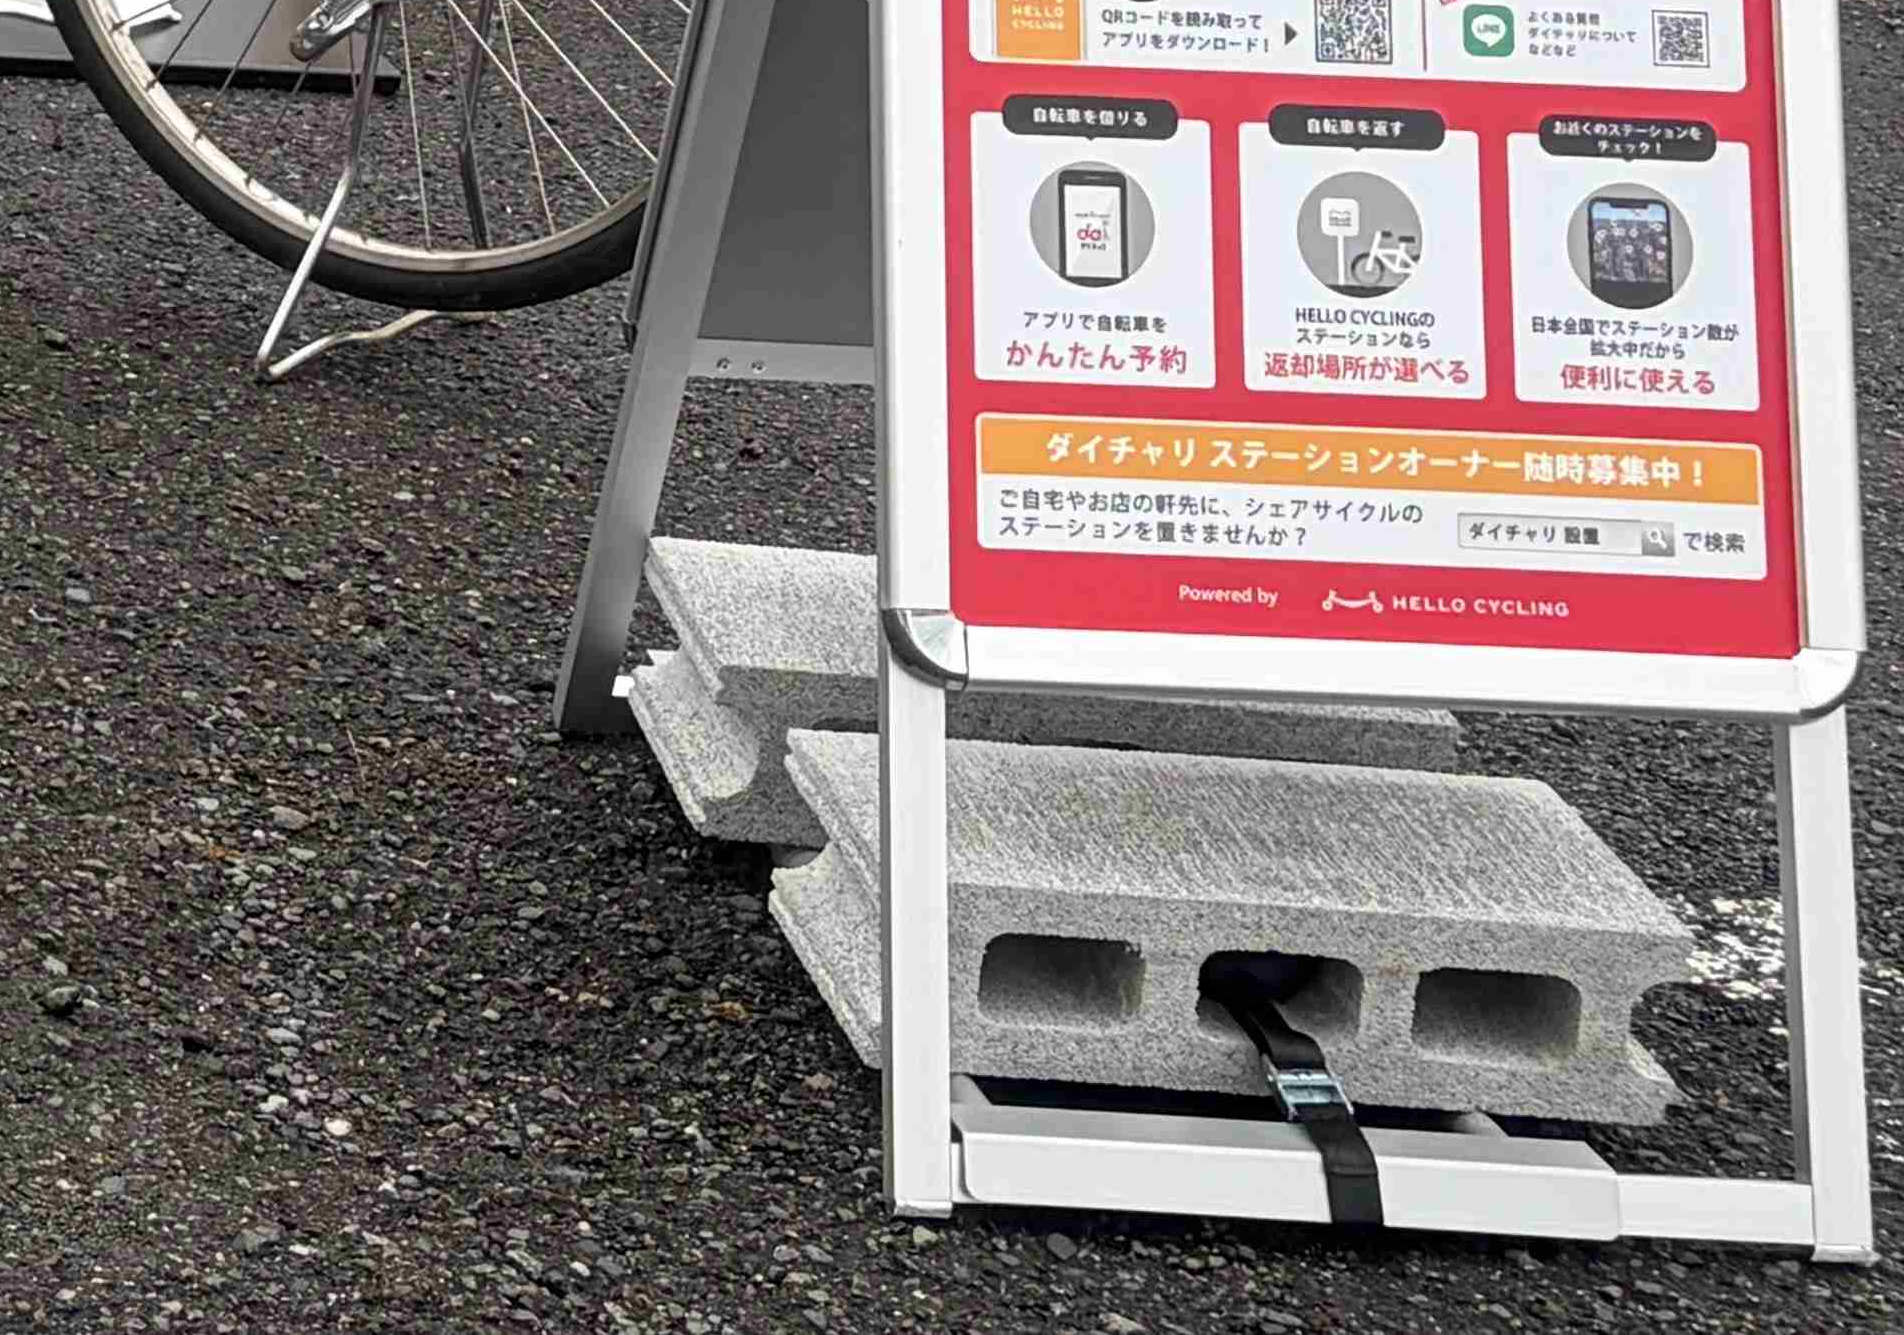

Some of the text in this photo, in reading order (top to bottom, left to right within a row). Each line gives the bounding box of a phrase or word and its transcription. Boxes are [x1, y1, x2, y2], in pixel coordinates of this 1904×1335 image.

[1101, 9, 1262, 29] QRコードを読み取って
[1033, 108, 1148, 128] 自転車を借りる
[1023, 311, 1168, 333] アプリで自転車を
[1295, 307, 1435, 327] HELLO CYCLINGの
[1297, 328, 1431, 349] ステーションなら
[1531, 316, 1739, 342] 日本全国でステーション数が
[1006, 340, 1187, 374] かんたん予約
[1264, 352, 1469, 384] 返却場所が選べる
[1561, 363, 1715, 395] 便利に使える
[999, 488, 1423, 524] ご自宅やお店の軒先に、シェアサイクルの
[999, 515, 1307, 547] ステーションを置きませんか？
[1469, 524, 1556, 543] ダイチャリ
[1683, 532, 1745, 553] で検索
[1178, 584, 1278, 607] Powered by
[1393, 596, 1569, 618] HELLO CYCLING
